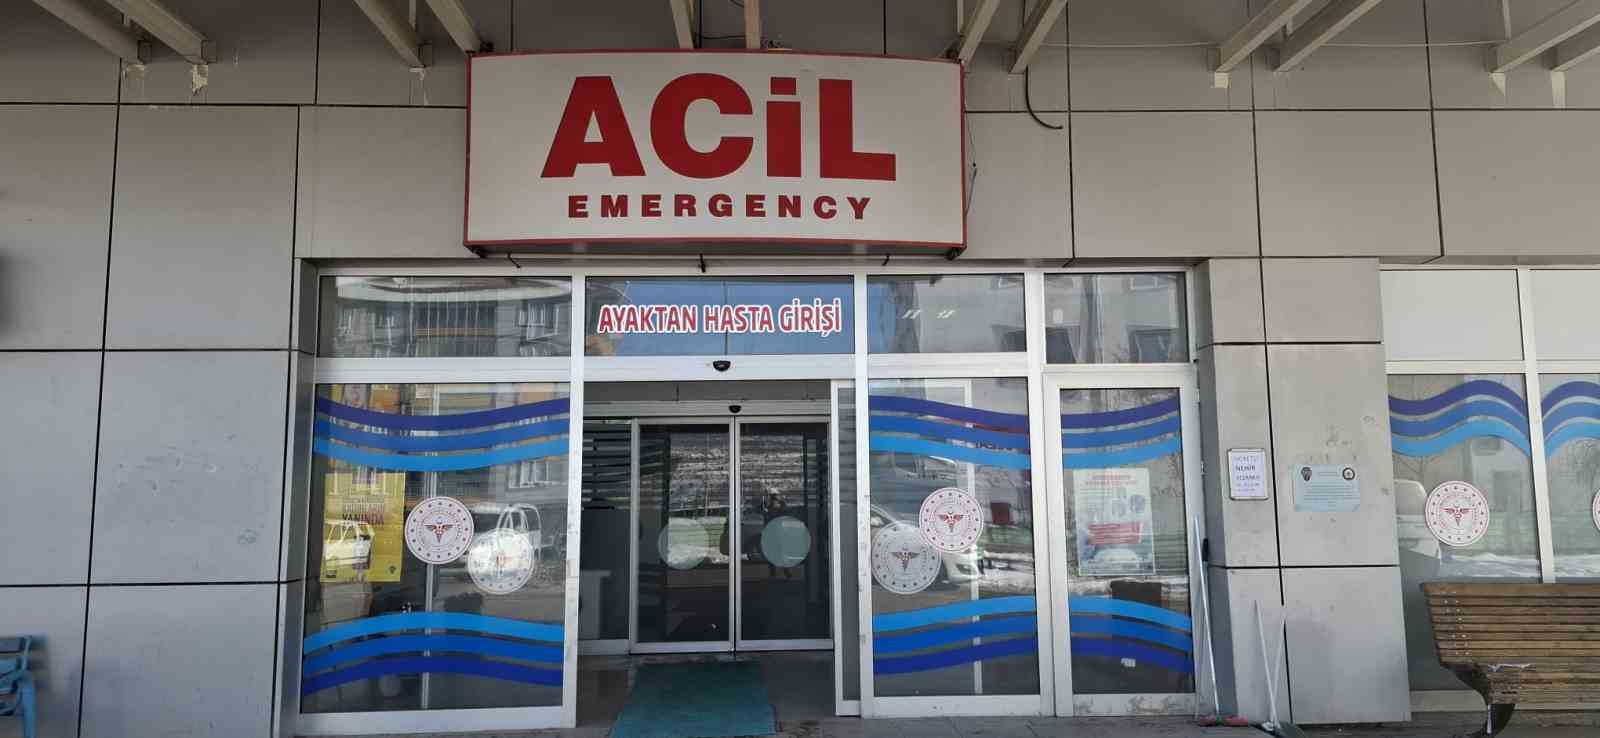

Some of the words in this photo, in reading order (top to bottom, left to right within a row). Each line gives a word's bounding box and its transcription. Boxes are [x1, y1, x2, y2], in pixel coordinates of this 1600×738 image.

[568, 193, 871, 220] EMERGENCY
[598, 305, 697, 333] AYAKTAN
[704, 305, 774, 333] HASTA
[779, 298, 842, 337] GİRİŞİ
